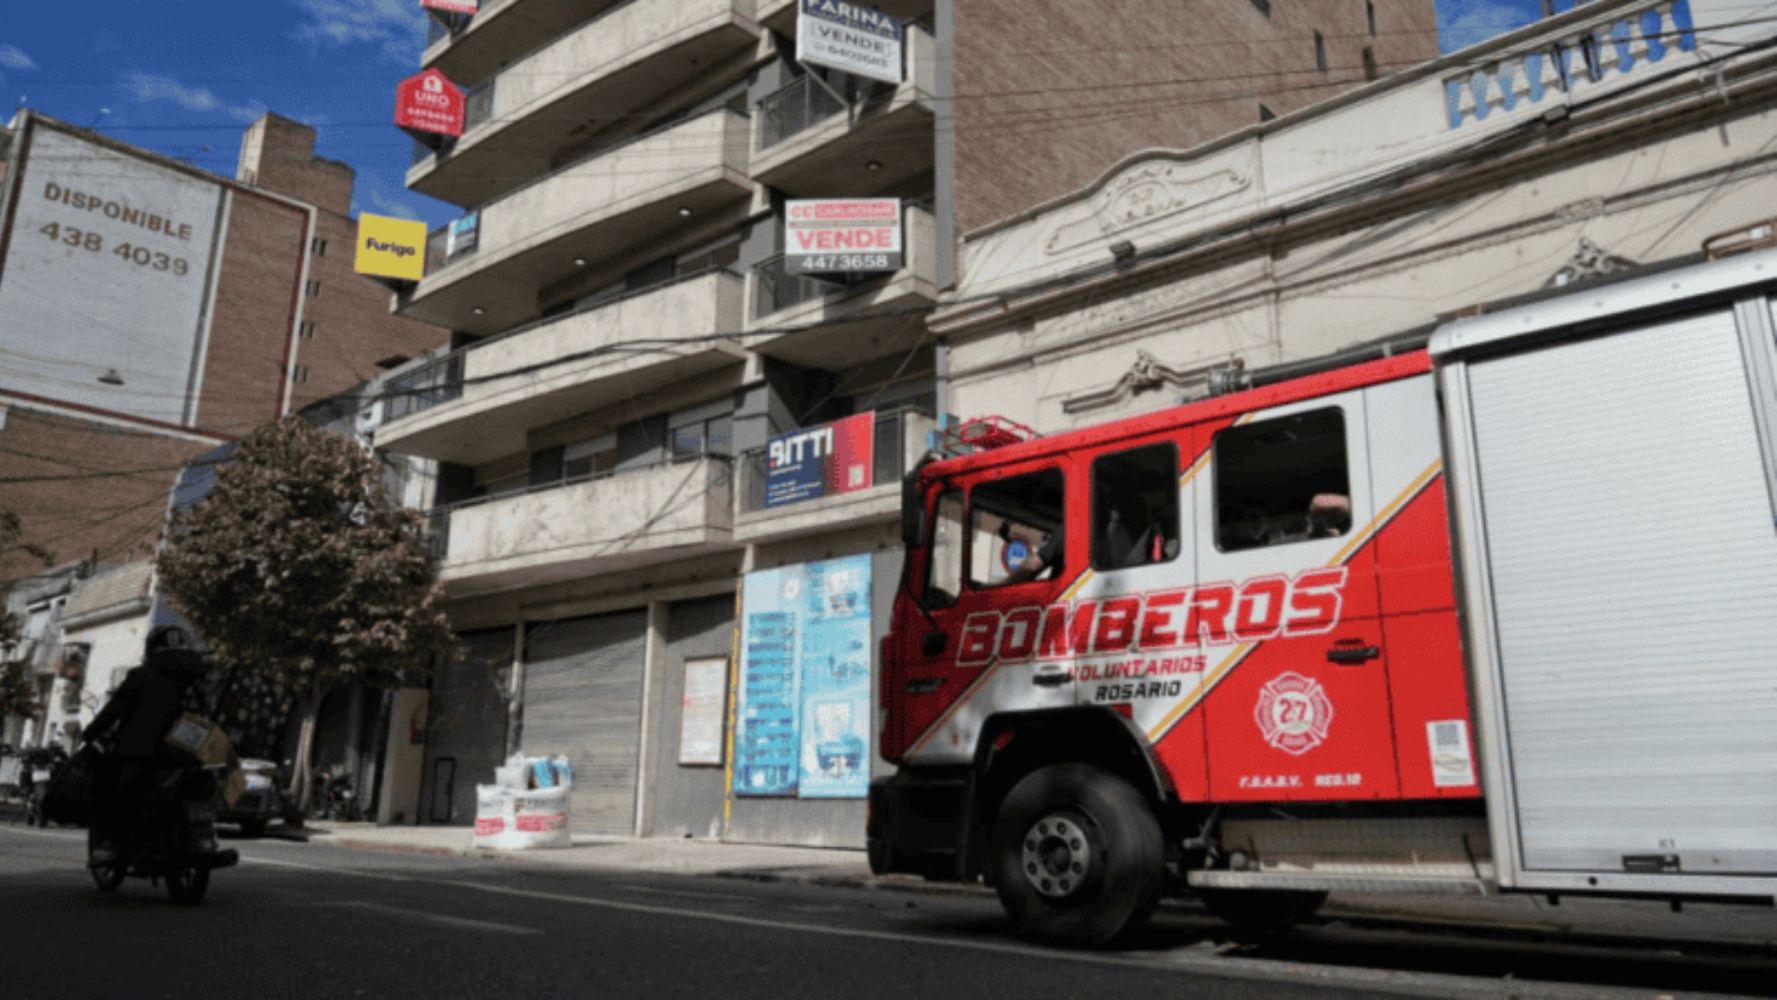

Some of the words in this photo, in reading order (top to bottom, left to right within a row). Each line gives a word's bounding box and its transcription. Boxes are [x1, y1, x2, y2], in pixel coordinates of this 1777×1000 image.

[818, 25, 884, 54] VENDE
[414, 90, 450, 109] UNO
[43, 181, 193, 241] DISPONIBLE
[39, 221, 103, 252] 438
[112, 241, 189, 276] 4039
[366, 237, 416, 257] Furigo
[796, 228, 893, 250] VENDE
[802, 254, 889, 269] 4473658
[956, 566, 1348, 666] BOMBEROS
[1067, 655, 1207, 682] VOLUNTARIOS
[1096, 679, 1182, 700] ROSARIO
[1279, 700, 1308, 724] 27
